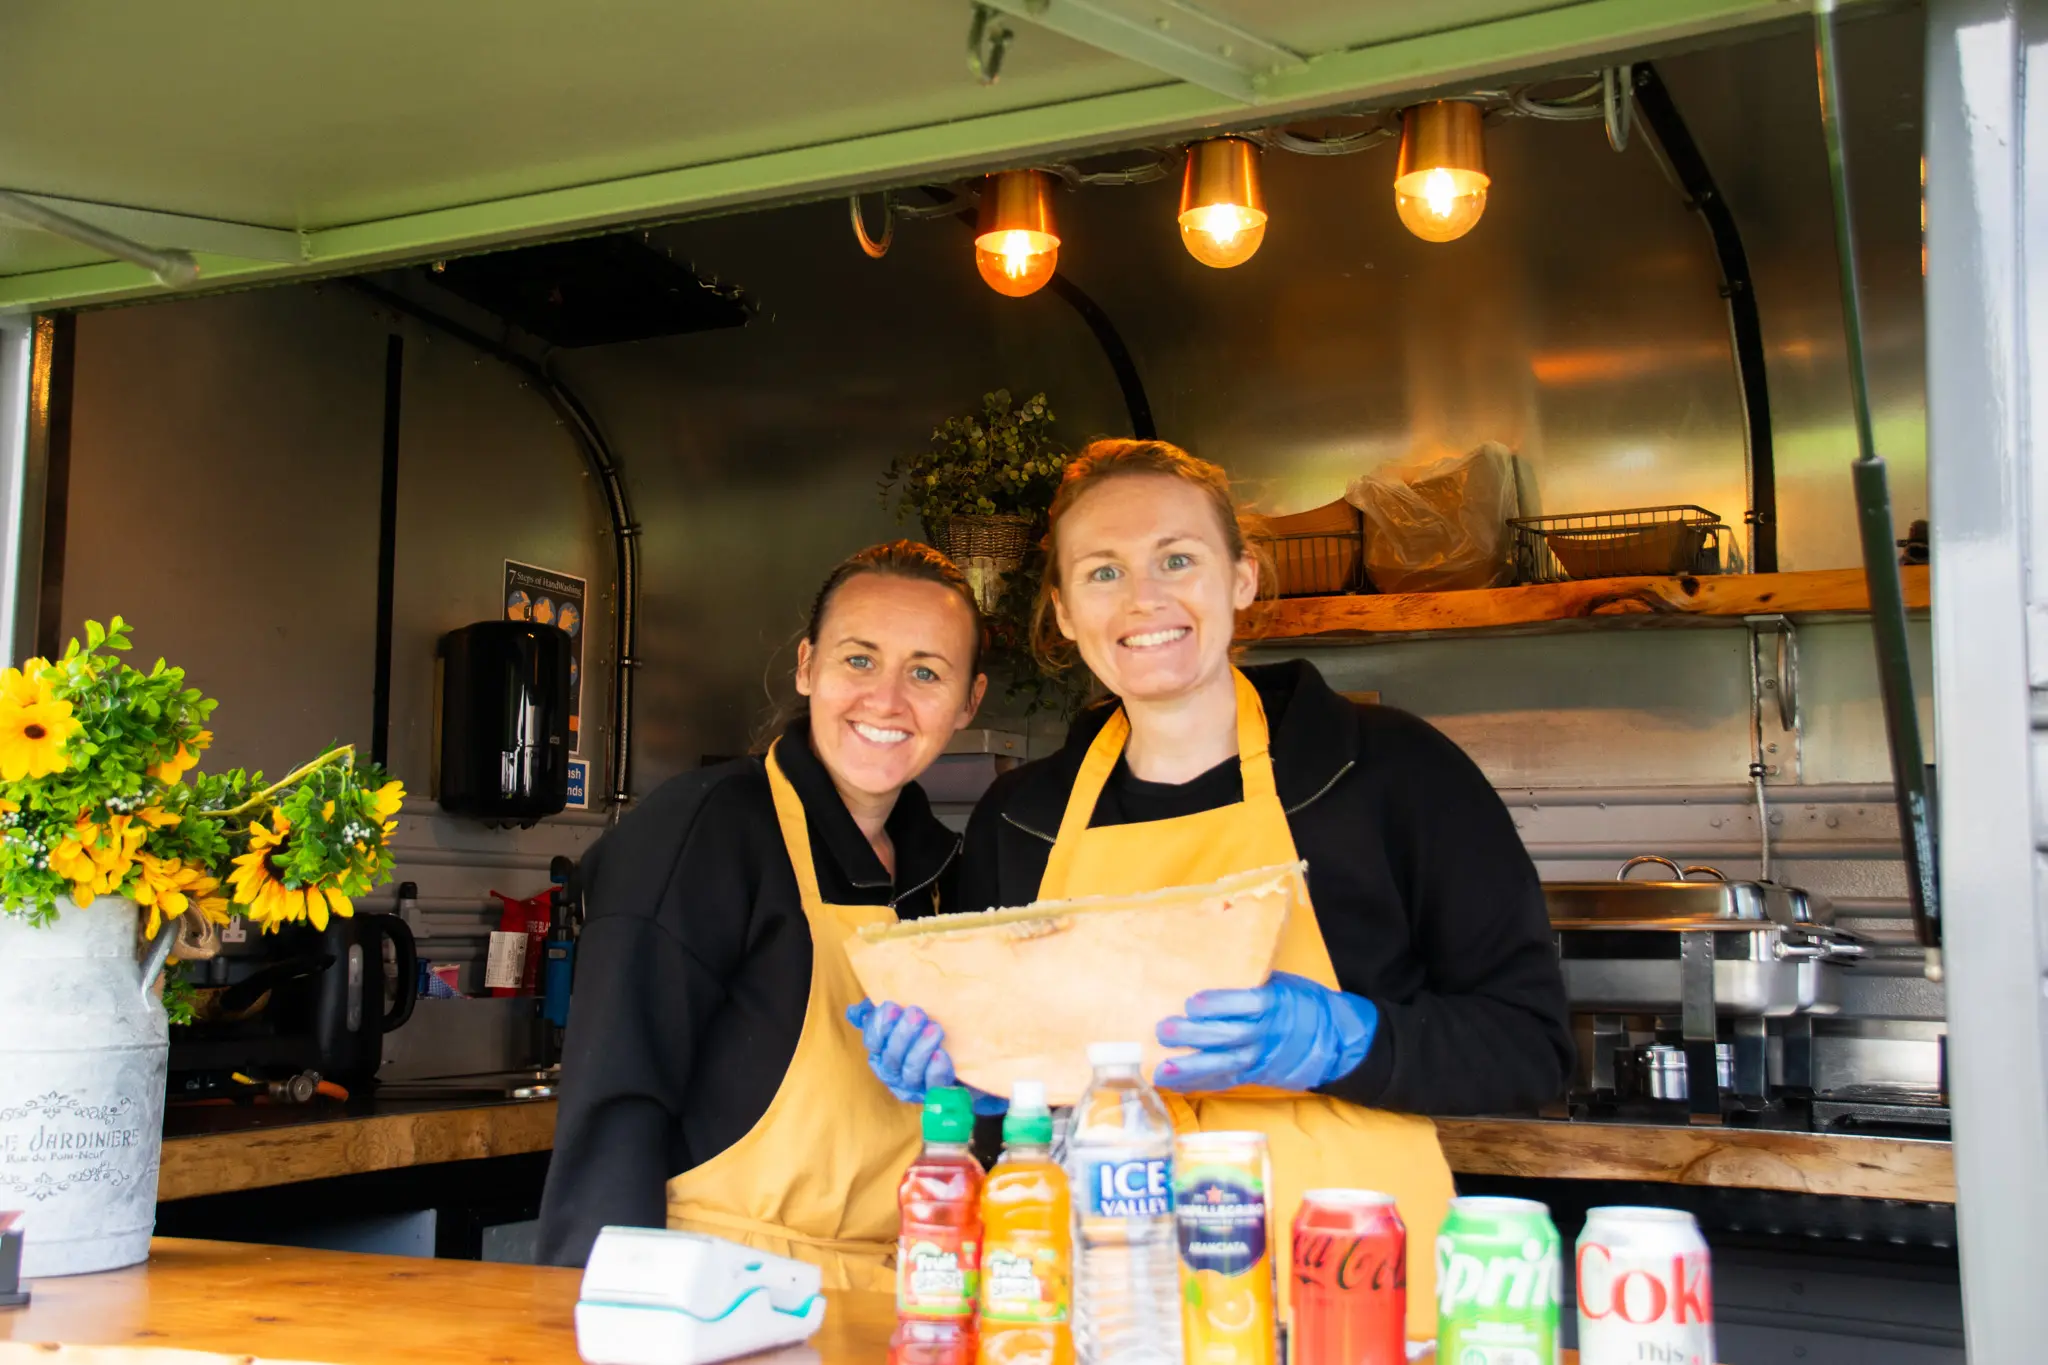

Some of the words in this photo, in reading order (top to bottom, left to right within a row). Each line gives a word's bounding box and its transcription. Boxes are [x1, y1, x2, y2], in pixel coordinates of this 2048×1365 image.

[509, 569, 517, 585] 7
[517, 572, 534, 584] Steps
[567, 768, 582, 780] ash
[566, 785, 583, 797] nds
[1101, 1161, 1166, 1198] ICE
[1101, 1199, 1166, 1216] VALLEY
